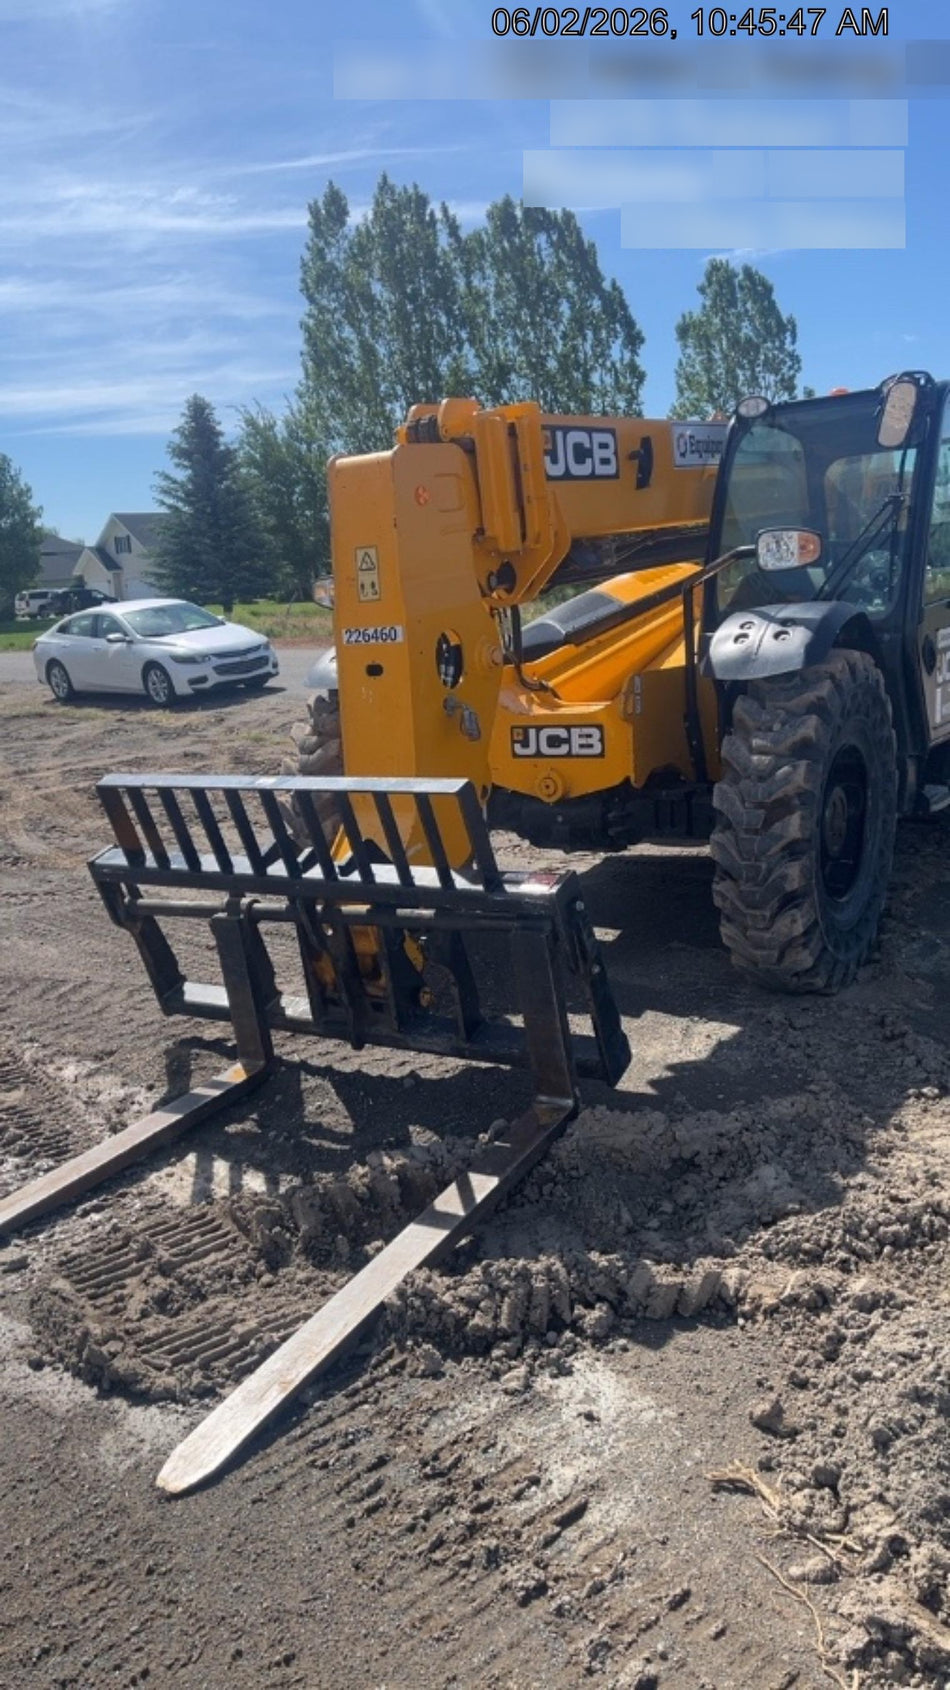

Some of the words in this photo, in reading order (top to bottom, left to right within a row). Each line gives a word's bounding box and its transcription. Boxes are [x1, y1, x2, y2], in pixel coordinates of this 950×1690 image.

[543, 430, 617, 476] JCB
[344, 627, 397, 644] 226460
[513, 727, 602, 755] JCB
